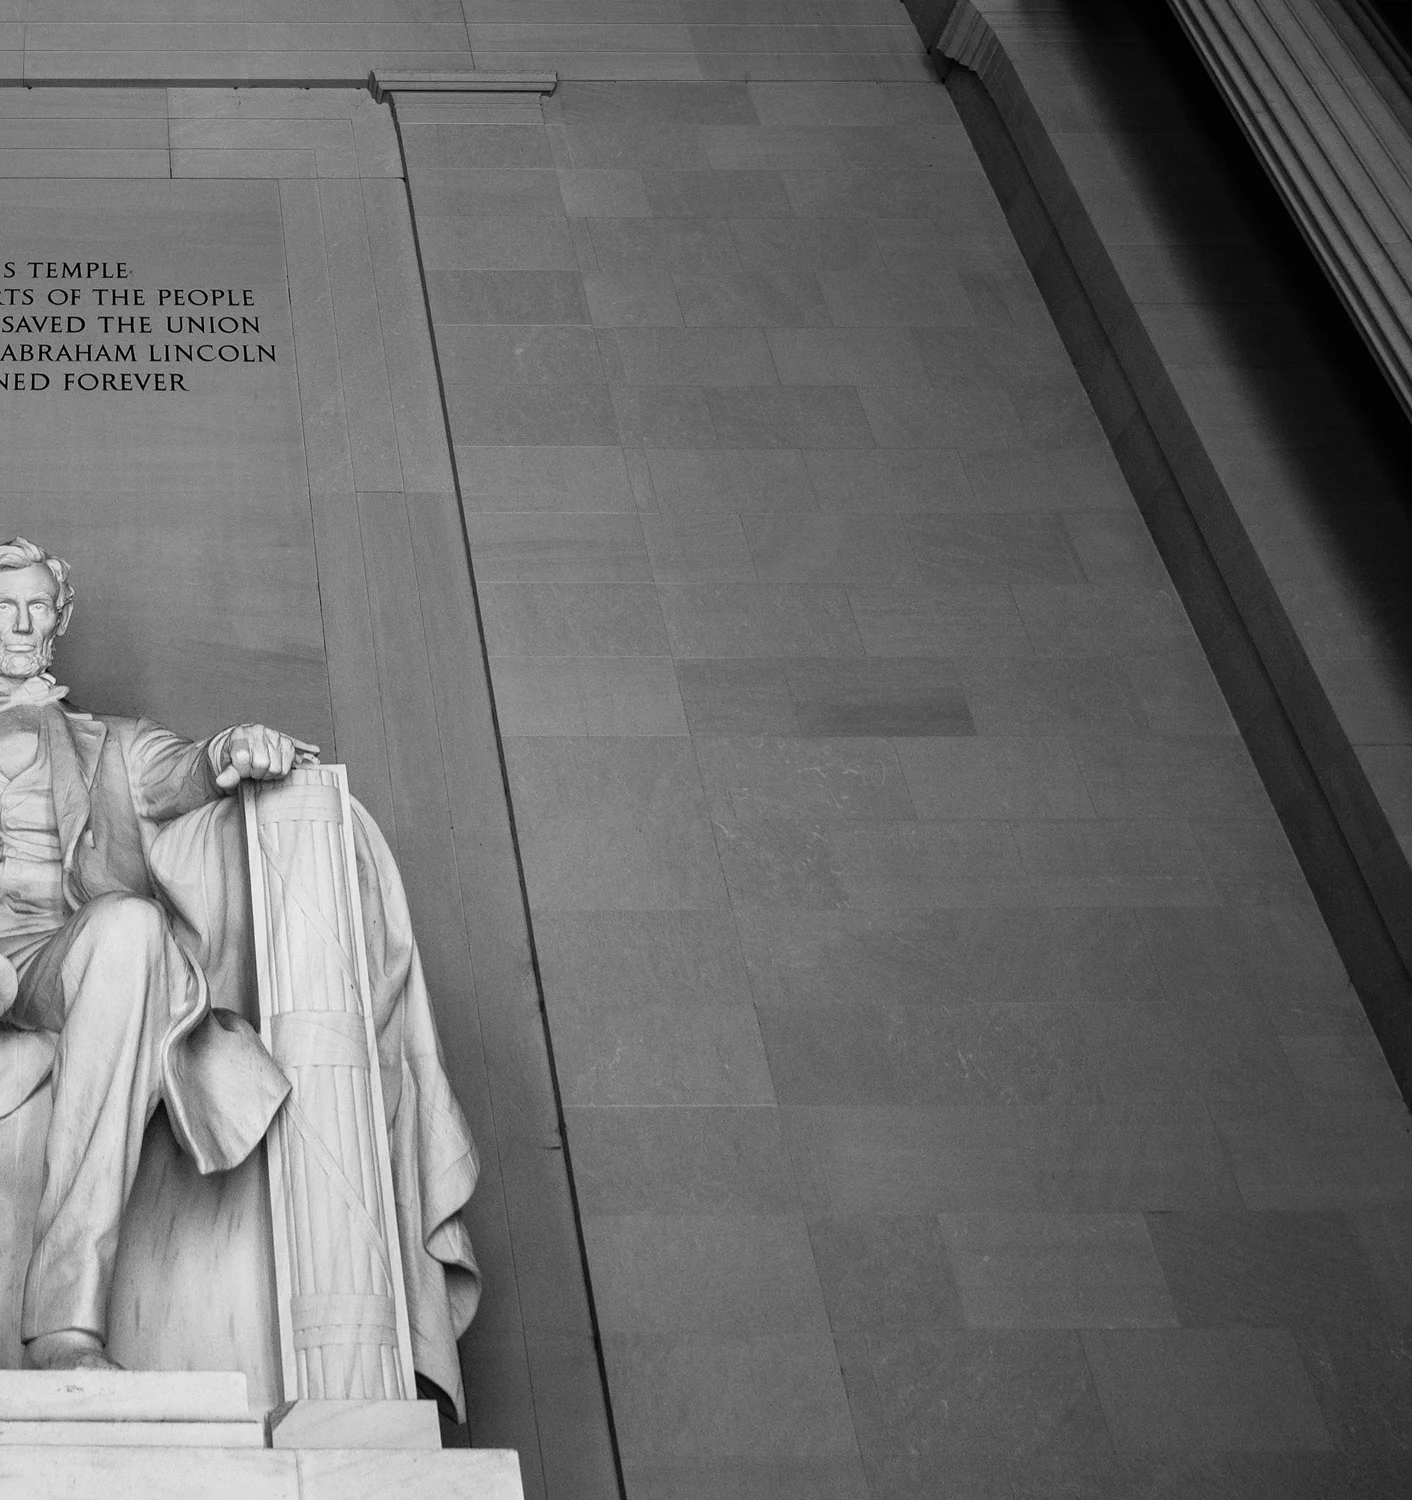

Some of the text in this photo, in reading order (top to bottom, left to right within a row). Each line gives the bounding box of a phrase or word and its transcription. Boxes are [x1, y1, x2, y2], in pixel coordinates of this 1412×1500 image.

[26, 261, 129, 279] TEMPLE
[47, 288, 81, 306] OF
[91, 288, 146, 307] THE
[156, 288, 255, 307] PEOPLE
[1, 315, 86, 334] SAVED
[96, 315, 153, 334] THE
[166, 315, 260, 334] UNION
[148, 343, 277, 363] LINCOLN
[63, 372, 191, 392] FOREVER
